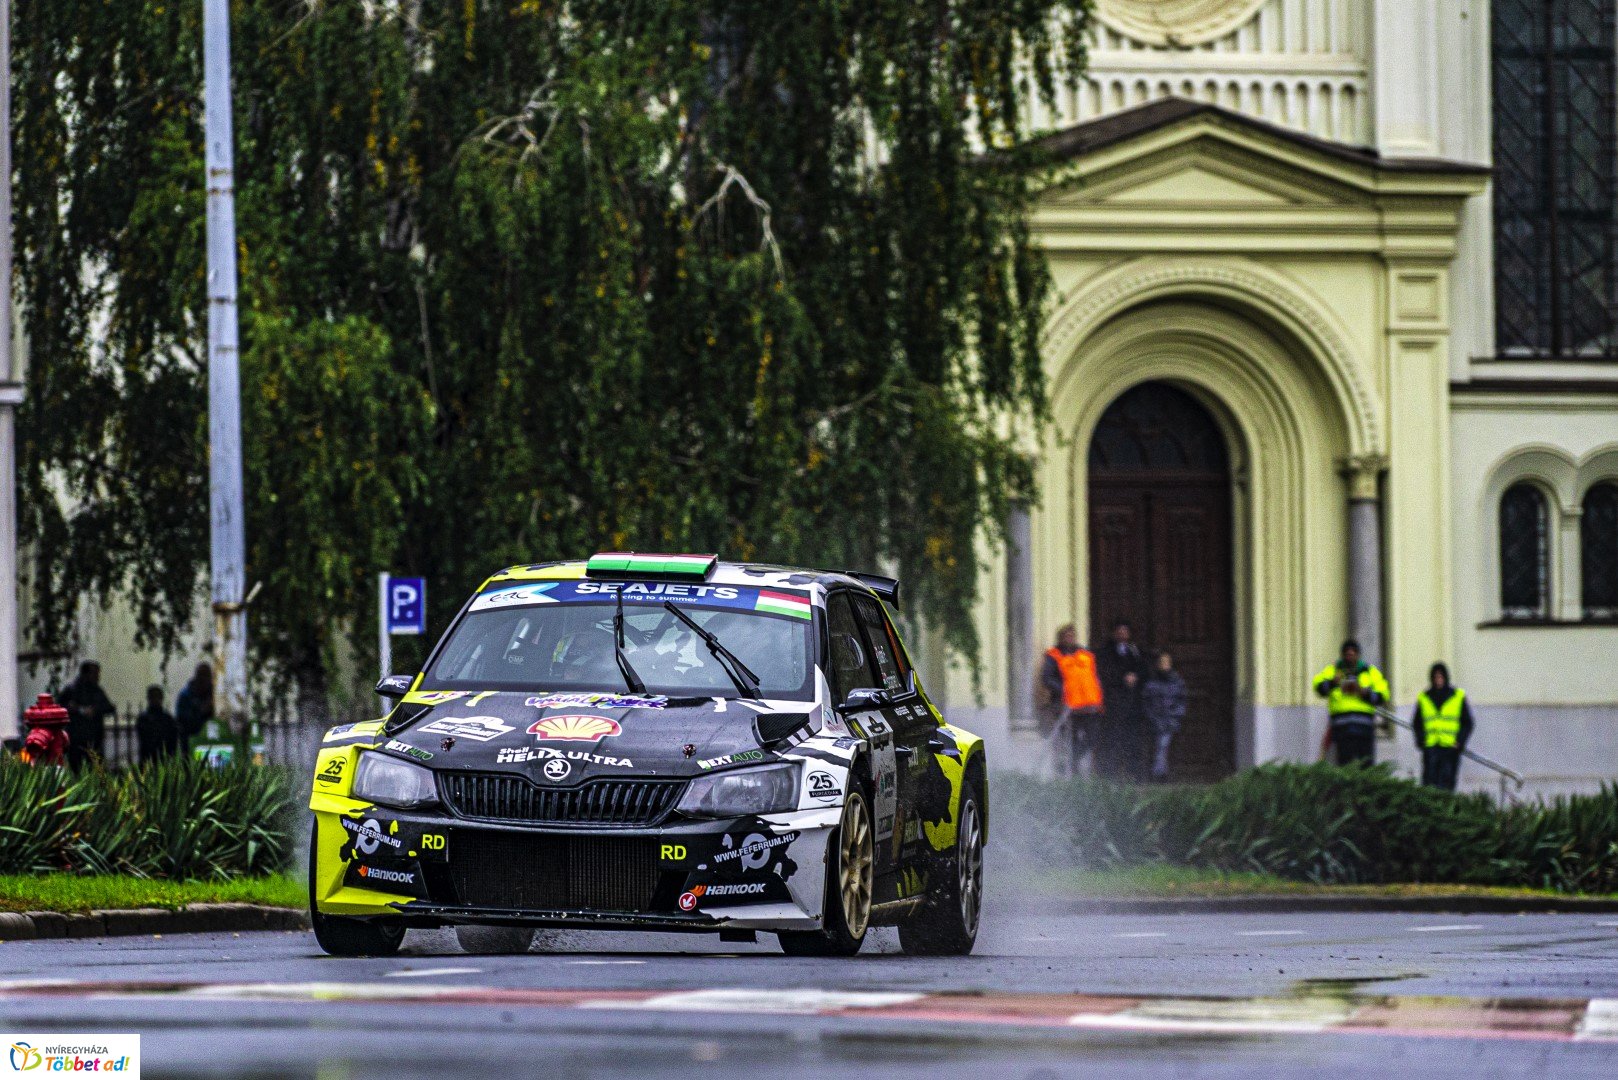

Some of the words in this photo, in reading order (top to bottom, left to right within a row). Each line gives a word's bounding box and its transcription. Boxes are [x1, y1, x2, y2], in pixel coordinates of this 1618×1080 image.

[575, 582, 738, 600] SEAJETS
[610, 593, 643, 601] Rcing
[393, 585, 417, 619] P
[497, 748, 566, 764] HELIX
[567, 751, 634, 768] ULTRA
[500, 746, 530, 755] Shell
[325, 760, 345, 775] 25
[809, 774, 833, 790] 25
[421, 833, 445, 850] RD
[714, 833, 795, 863] WWW.FEFERRUM.HU
[660, 844, 687, 860] RD
